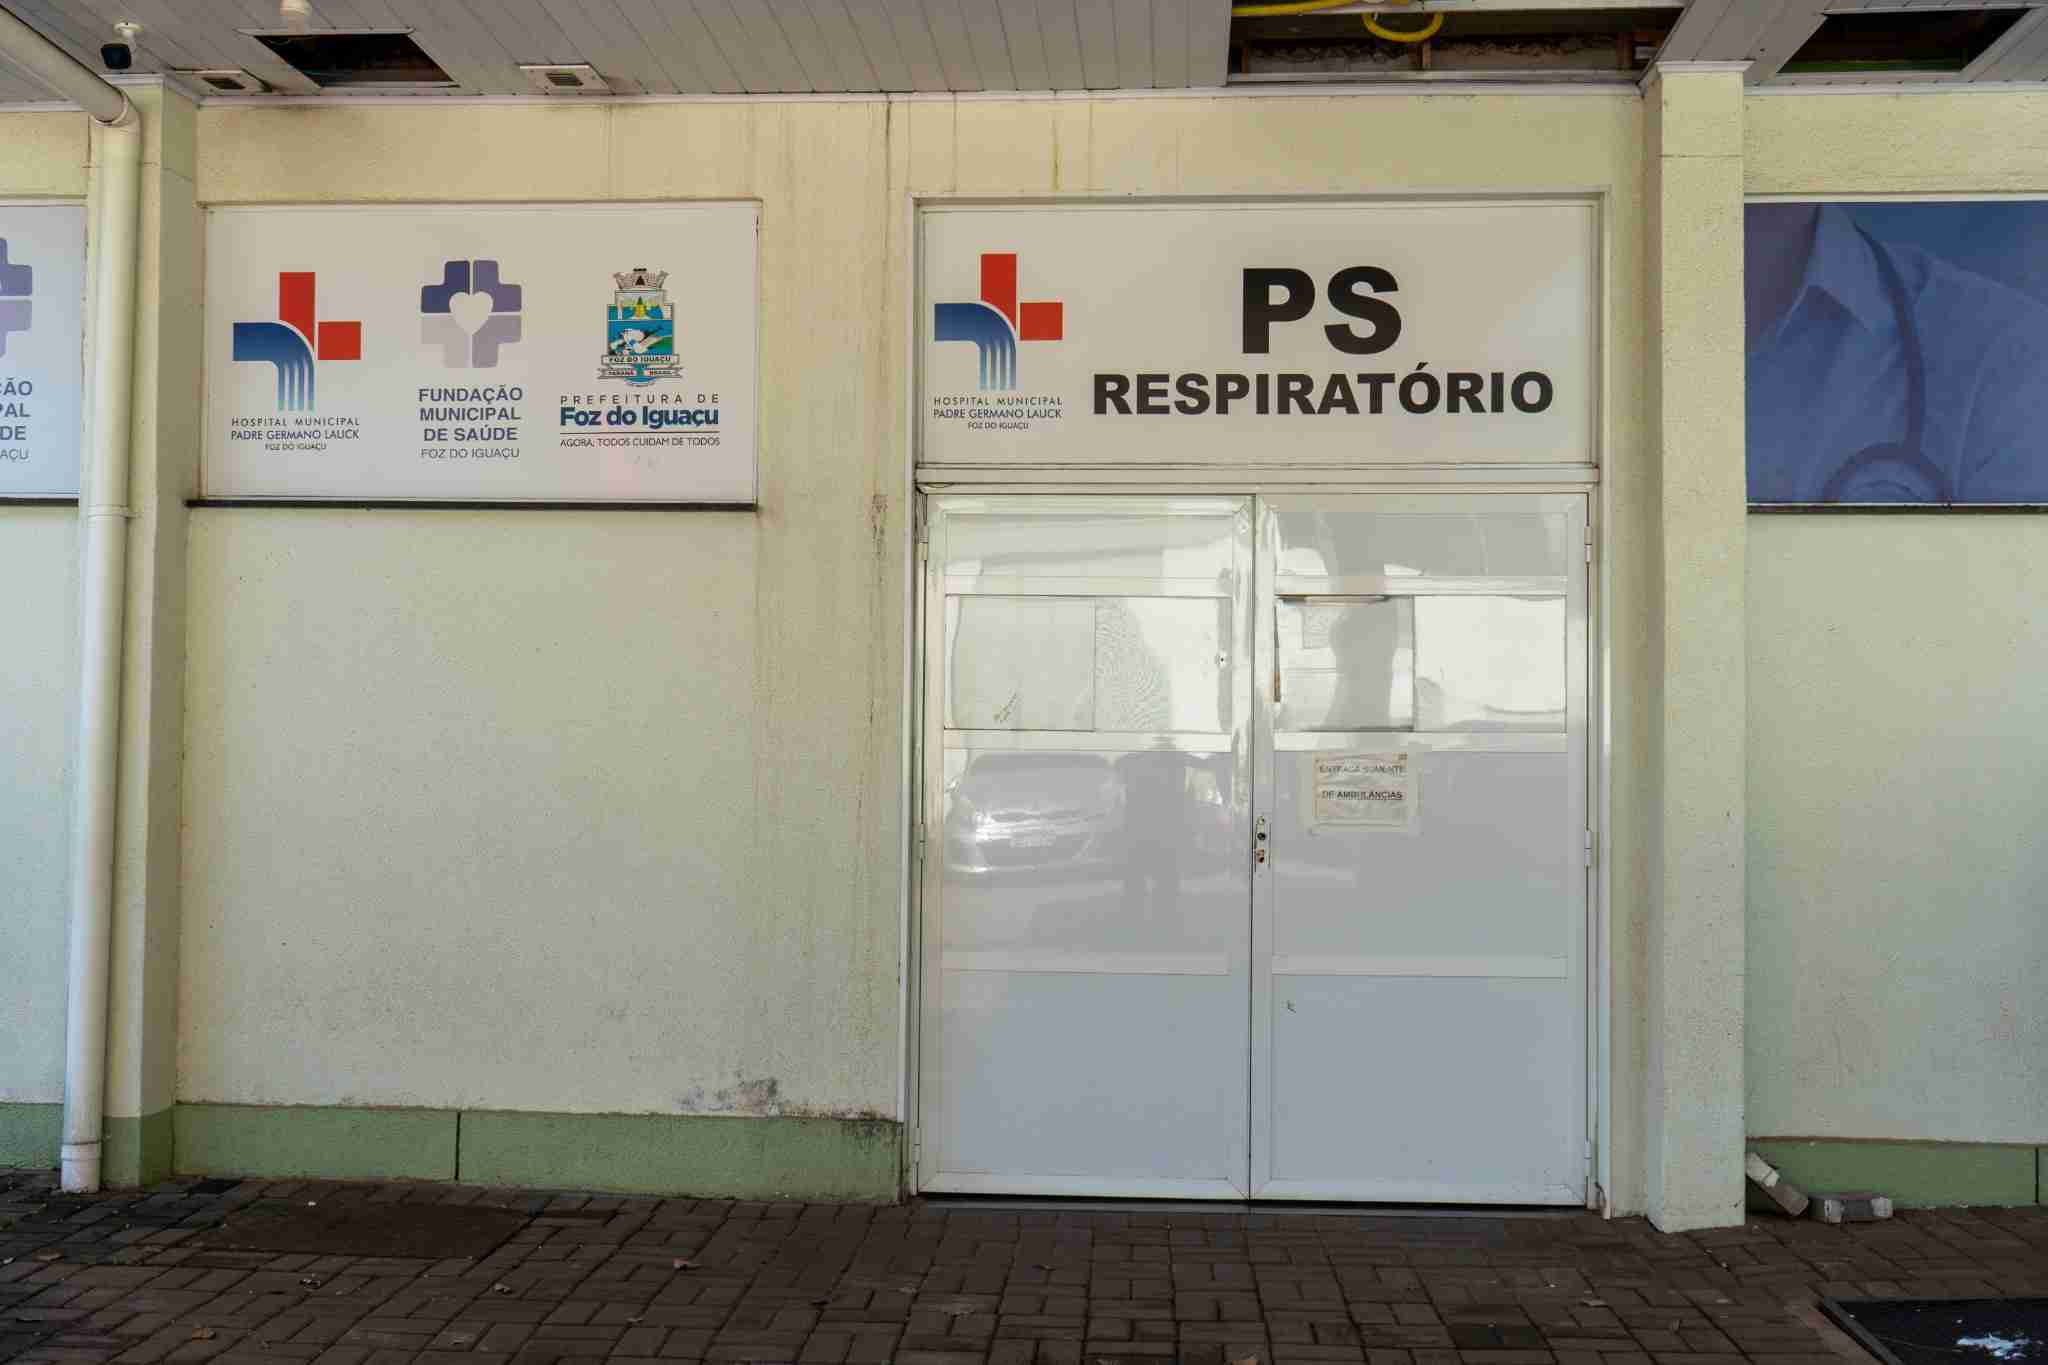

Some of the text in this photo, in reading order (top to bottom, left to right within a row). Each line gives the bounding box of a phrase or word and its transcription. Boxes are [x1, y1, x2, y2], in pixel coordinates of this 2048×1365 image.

[1242, 266, 1402, 355] PS
[0, 377, 33, 396] ÃO
[1093, 362, 1554, 415] RESPIRATÓRIO
[418, 384, 523, 404] FUNDAÇÃO
[560, 393, 719, 405] PREFEITURA DE
[933, 396, 1062, 406] HOSPITAL MUNICIPAL
[420, 407, 521, 421] MUNICIPAL
[560, 405, 719, 429] Foz do Iguaçu
[933, 409, 1062, 418] PADRE GERMANO LAUCK
[231, 416, 360, 427] HOSPITAL MUNICIPAL
[967, 422, 982, 430] FOZ
[984, 422, 997, 430] DO
[0, 426, 26, 441] DE
[231, 429, 360, 440] PADRE GERMANO LAUCK
[424, 424, 519, 441] DE SAÚDE
[598, 437, 631, 447] TODOS
[632, 437, 670, 447] CUIDAM
[672, 437, 684, 446] DE
[687, 436, 720, 447] TODOS
[421, 448, 520, 461] FOZ DO IGUAÇU
